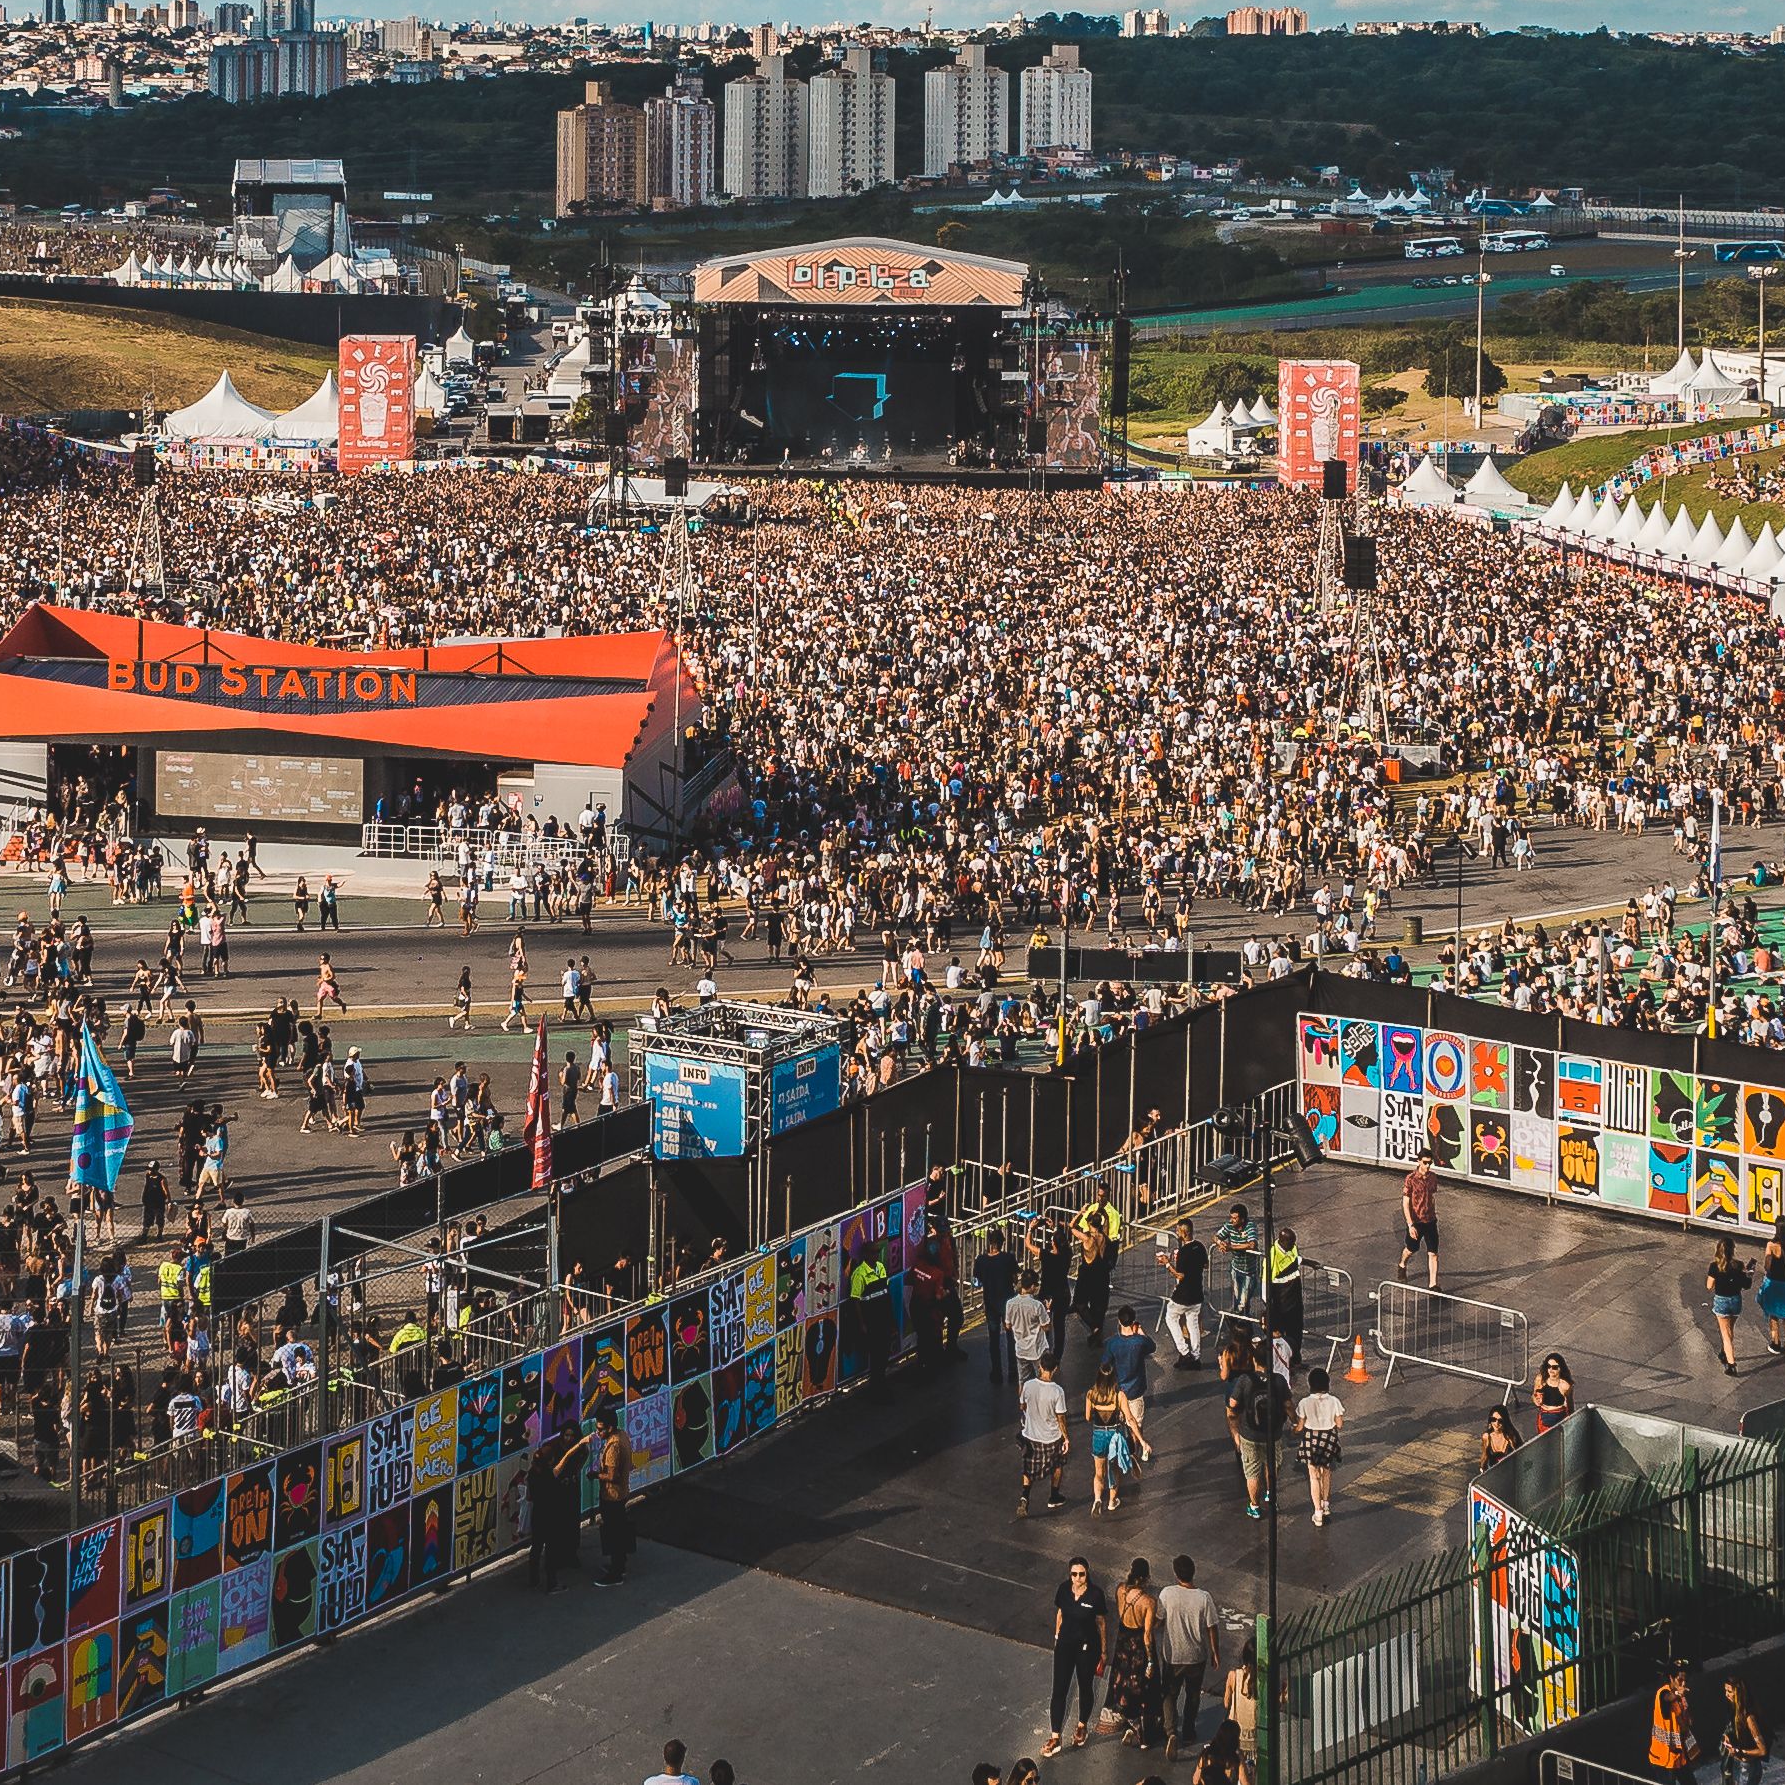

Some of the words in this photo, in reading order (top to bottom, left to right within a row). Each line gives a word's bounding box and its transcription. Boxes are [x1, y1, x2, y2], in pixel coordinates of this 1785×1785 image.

[787, 259, 930, 291] Lollapalooza
[108, 659, 200, 693] BUD
[220, 661, 416, 702] STATION
[683, 1068, 707, 1081] INFO
[798, 1060, 815, 1076] INFO
[662, 1081, 694, 1099] SAÍDA
[785, 1082, 810, 1104] SAÍDA
[1606, 1061, 1645, 1132] HIGH
[1385, 1093, 1423, 1130] STAY
[1514, 1128, 1552, 1150] ON
[1563, 1155, 1596, 1185] ON
[633, 1348, 664, 1381] ON
[419, 1398, 442, 1432] BE
[629, 1410, 669, 1438] ON
[370, 1414, 414, 1457] STAY
[629, 1428, 669, 1450] THE
[1484, 1502, 1503, 1521] LIKE
[87, 1523, 116, 1546] LIKE
[231, 1508, 269, 1548] ON
[80, 1540, 108, 1563] YOU
[320, 1532, 365, 1575] STAY
[71, 1565, 105, 1592] THAT
[74, 1555, 102, 1578] LIKE
[223, 1564, 270, 1590] TURN
[223, 1580, 268, 1609] ON
[221, 1603, 267, 1628] THE
